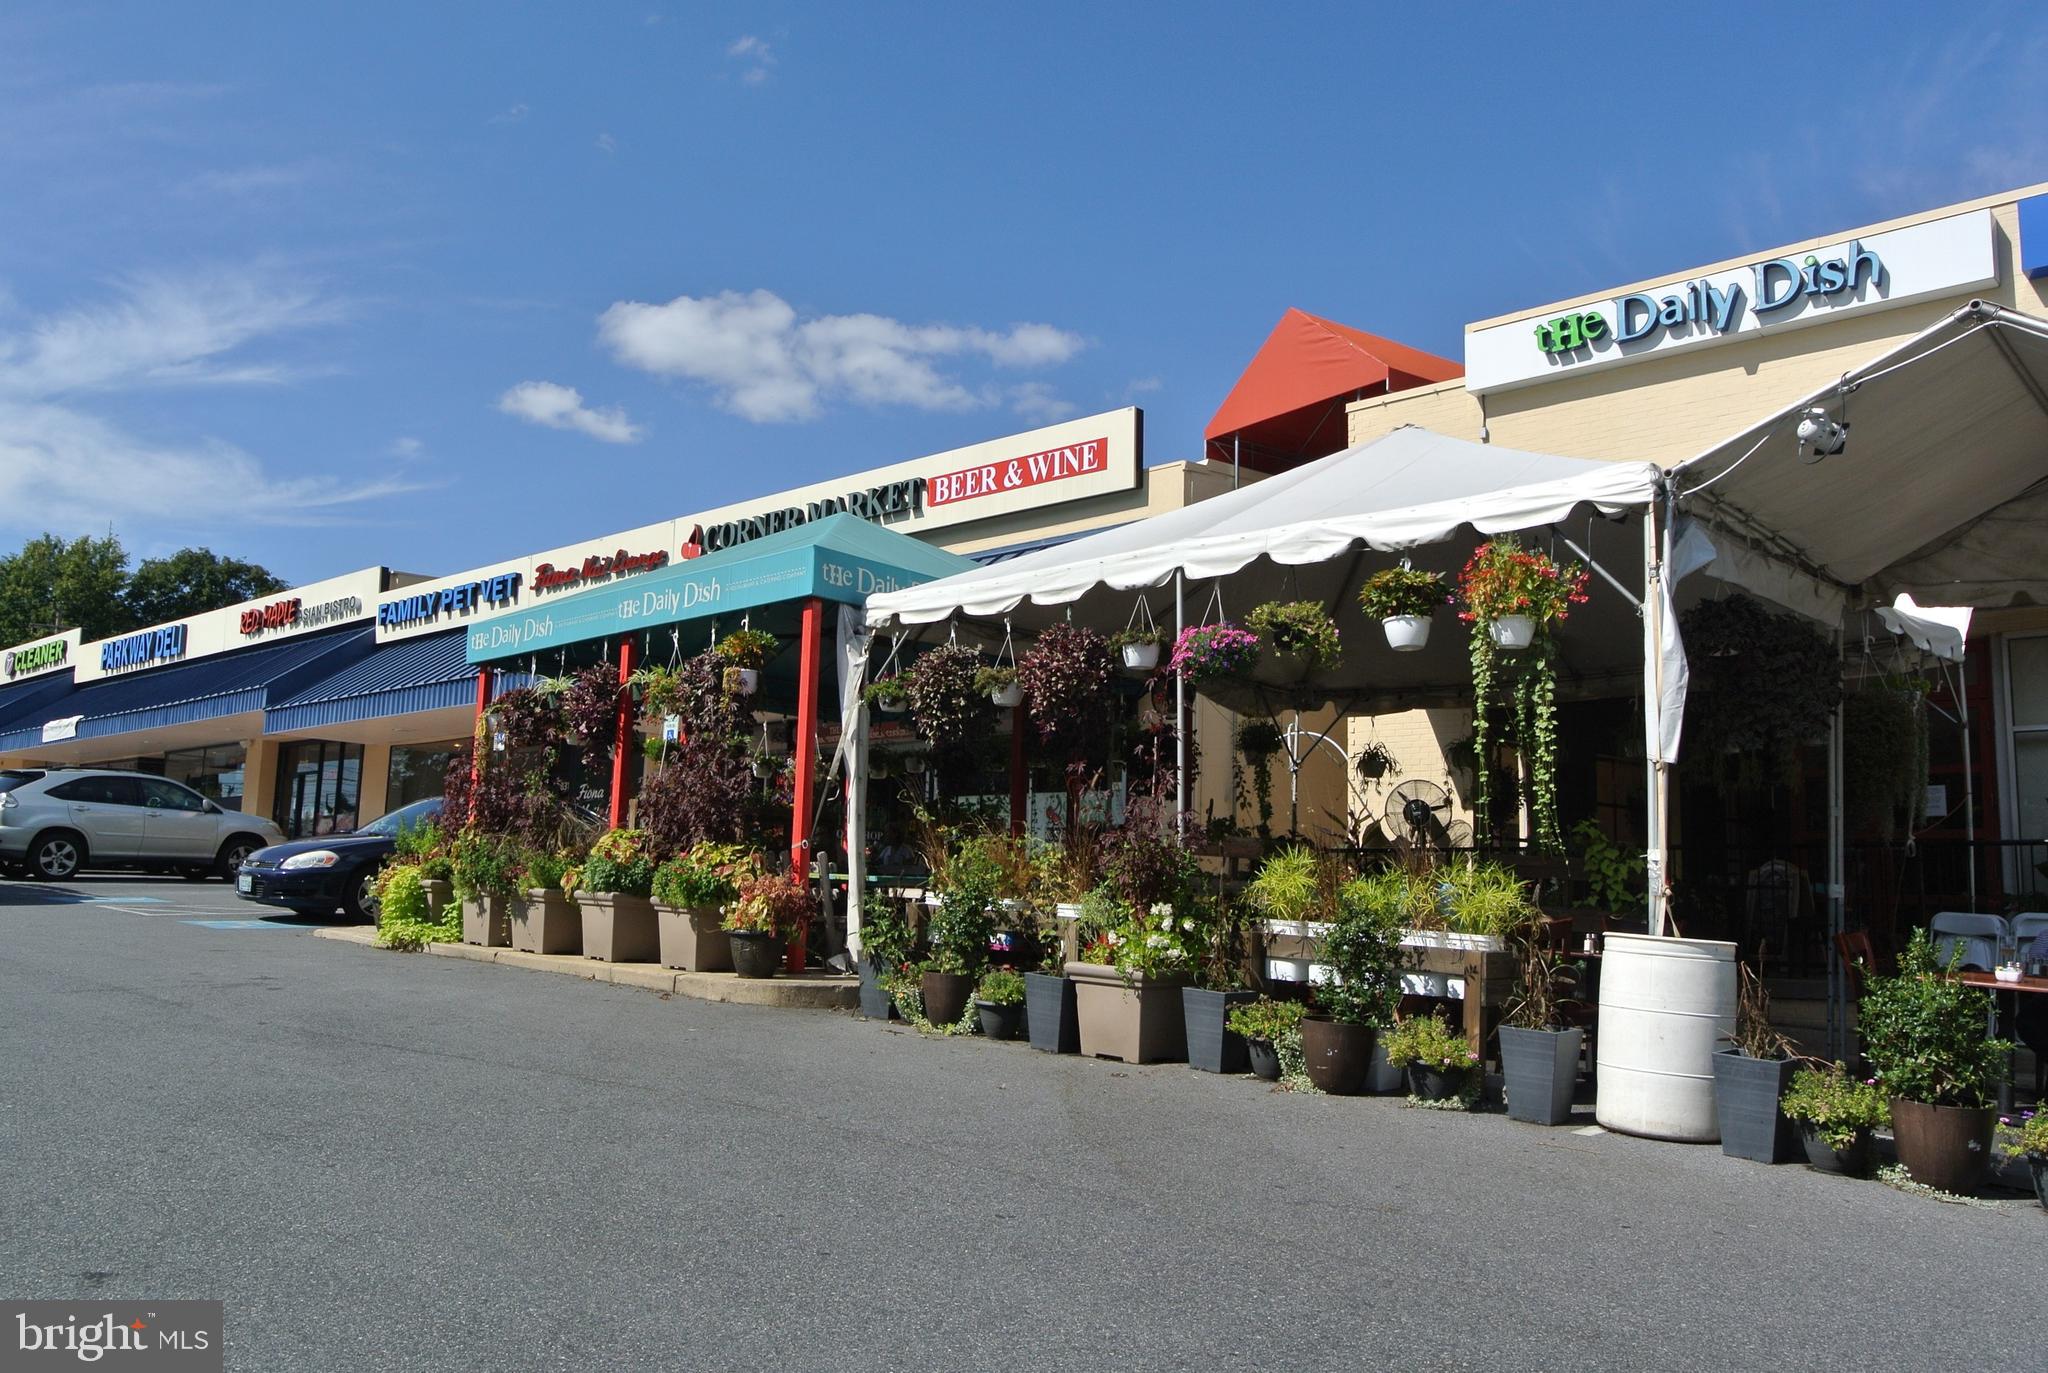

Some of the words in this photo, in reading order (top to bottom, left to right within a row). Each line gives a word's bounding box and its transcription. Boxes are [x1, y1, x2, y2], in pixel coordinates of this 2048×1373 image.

[1612, 279, 1741, 346] Daily
[1750, 240, 1883, 314] Dish
[934, 466, 997, 503] BEER
[1003, 460, 1023, 488] &
[1027, 442, 1098, 482] WINE
[703, 507, 803, 550] CORNER
[806, 478, 925, 520] MARKET
[240, 609, 262, 634] RED
[262, 598, 300, 629] MAPLE
[299, 605, 321, 621] ASIAN
[324, 596, 357, 615] BISTRO
[378, 592, 437, 625] FAMILY
[440, 582, 478, 612] PET
[480, 572, 520, 602] VET
[642, 588, 680, 616] Daily
[684, 577, 720, 608] Dish
[101, 632, 152, 670] PARKWAY
[155, 624, 186, 658] DELI
[491, 623, 522, 649] Daily
[524, 615, 553, 641] Dish
[14, 640, 66, 671] CLEANER
